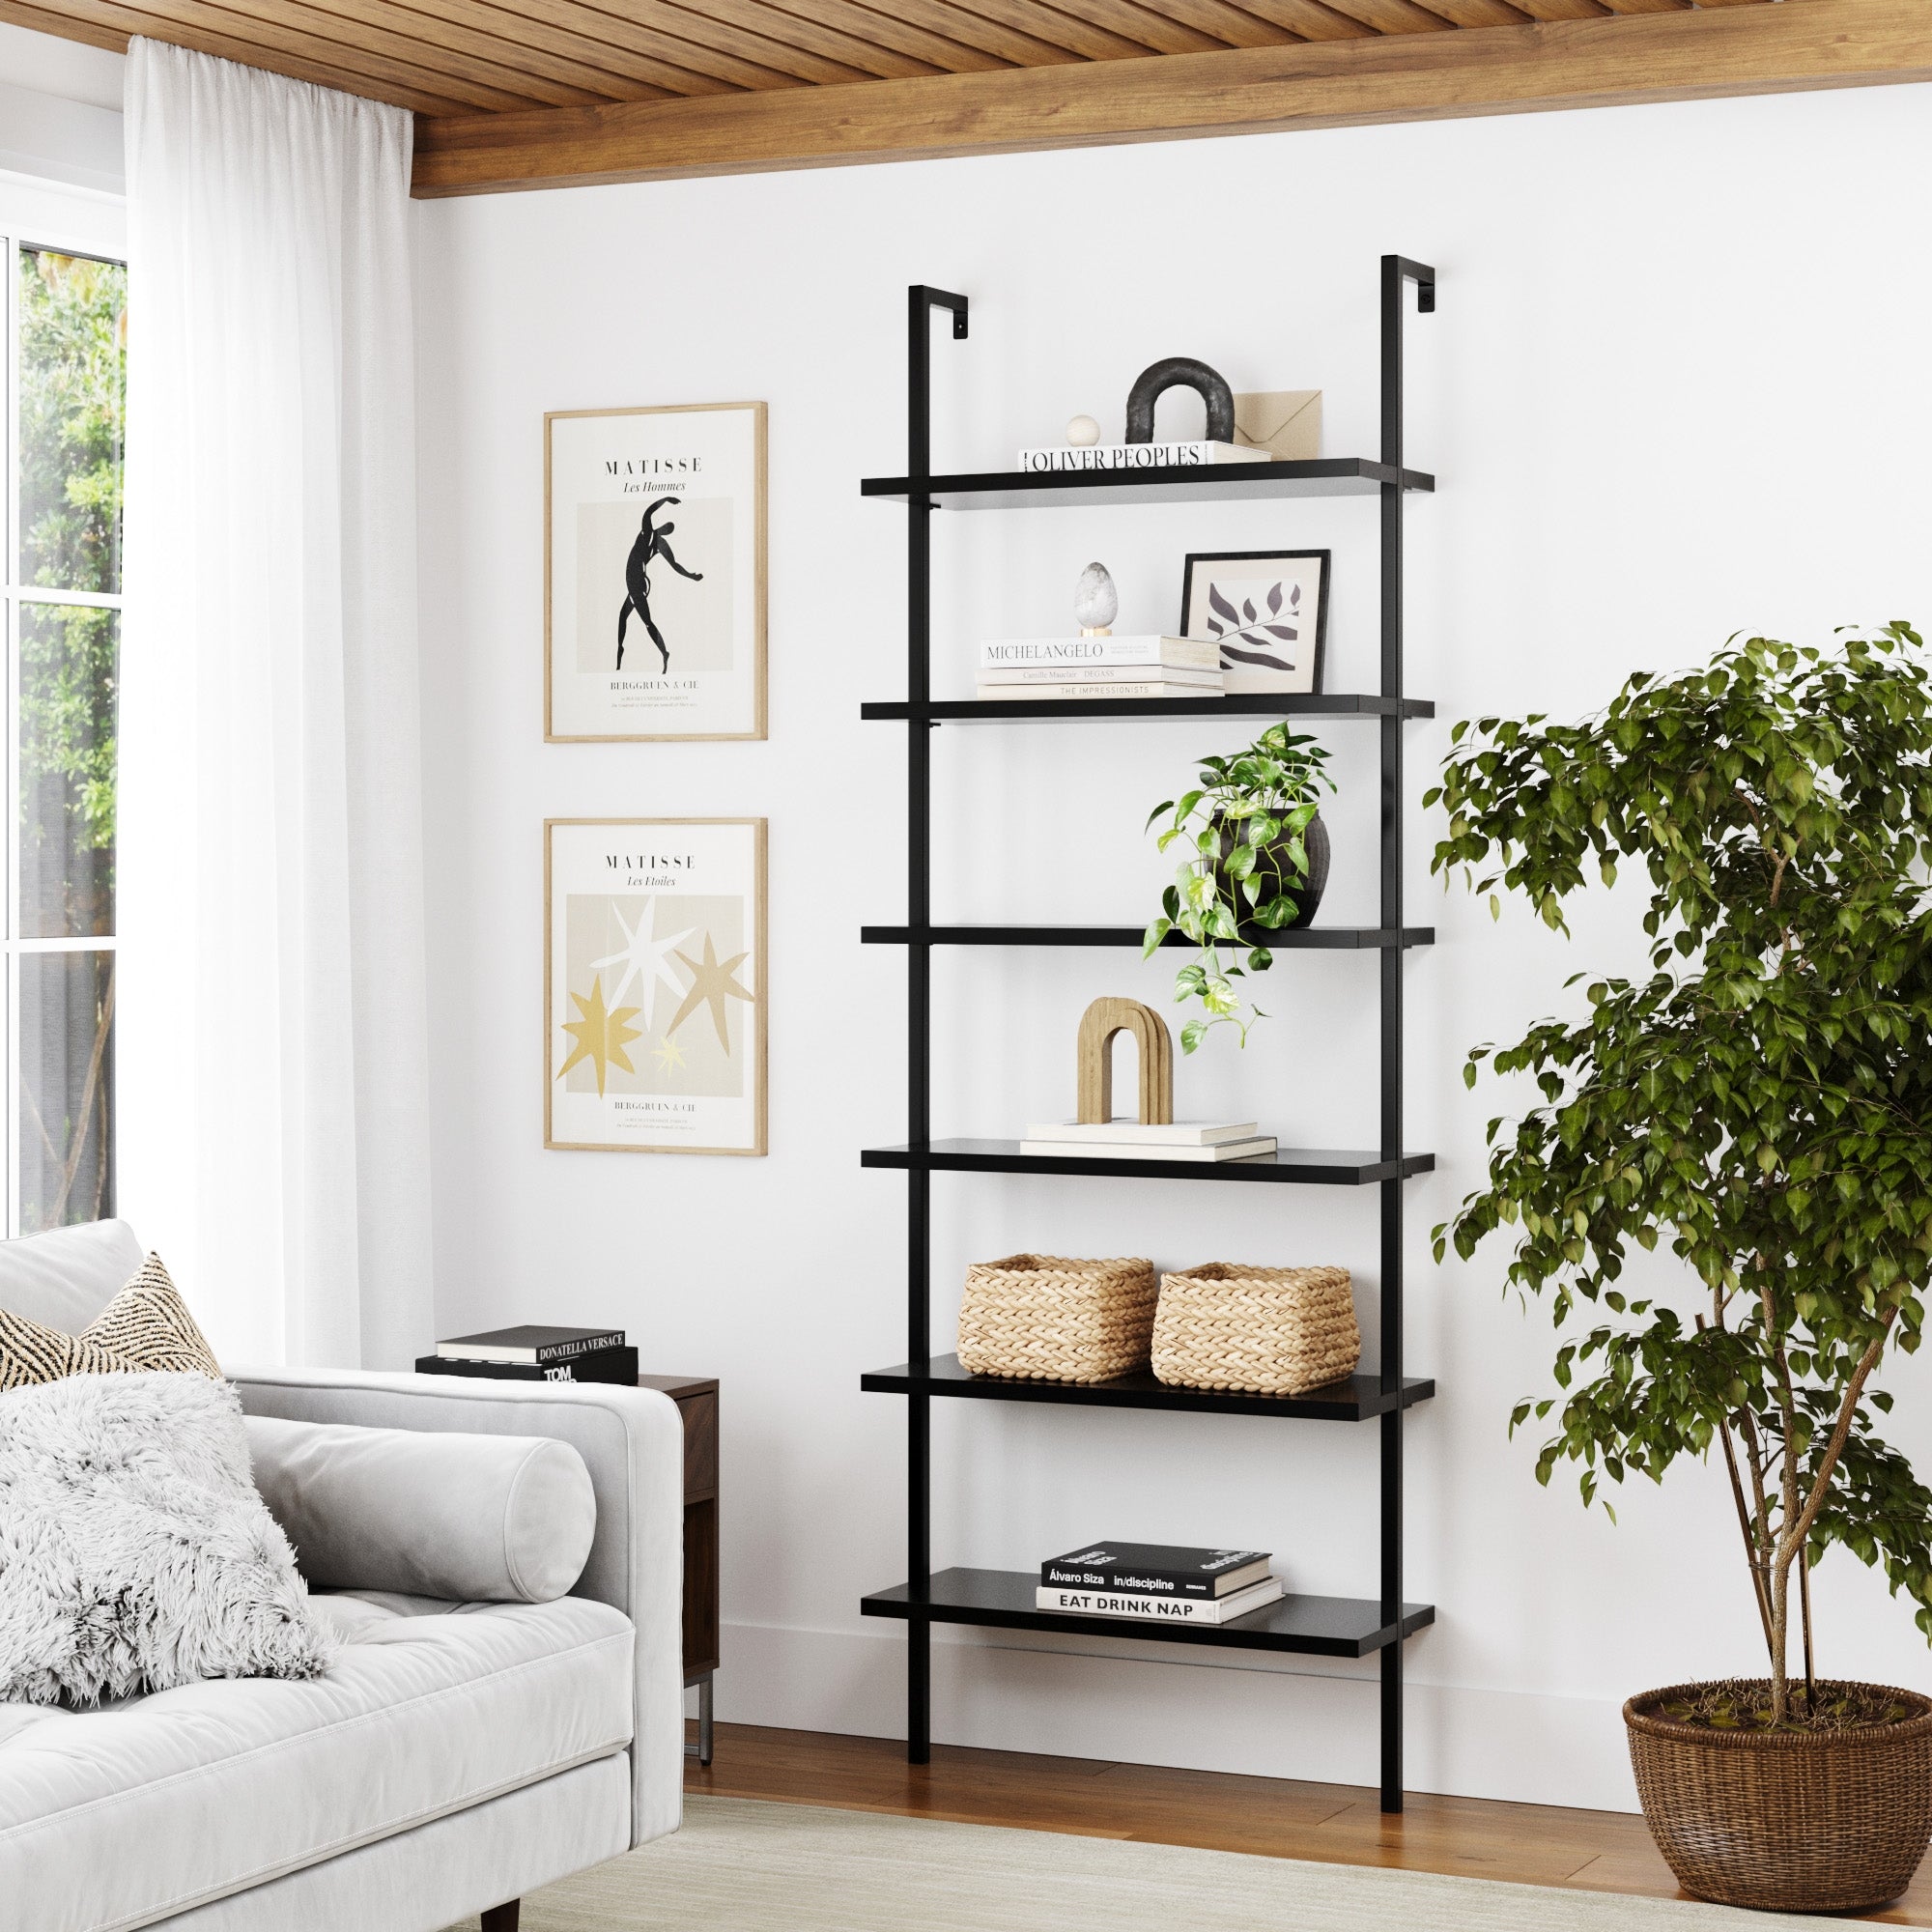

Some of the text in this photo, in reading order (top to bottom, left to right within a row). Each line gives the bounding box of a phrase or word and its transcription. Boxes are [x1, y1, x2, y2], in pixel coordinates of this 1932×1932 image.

[1032, 448, 1105, 471] OLIVER
[1111, 444, 1200, 469] PEOPLES
[604, 457, 702, 476] MATISSE
[623, 481, 687, 493] Les Hommes
[986, 643, 1103, 660] MICHELANGELO
[1061, 686, 1150, 696] THE IMPRESSIONISTS
[606, 855, 696, 869] MATISSE
[627, 876, 642, 886] Les
[540, 1334, 623, 1360] DONATELLA VERSACE
[544, 1365, 572, 1382] TOM
[1049, 1569, 1082, 1584] Álvaro
[1083, 1574, 1104, 1585] Siza
[1114, 1576, 1175, 1591] in/discipline
[1060, 1595, 1092, 1607] EAT
[1096, 1598, 1151, 1613] DRINK
[1157, 1604, 1193, 1617] NAP
